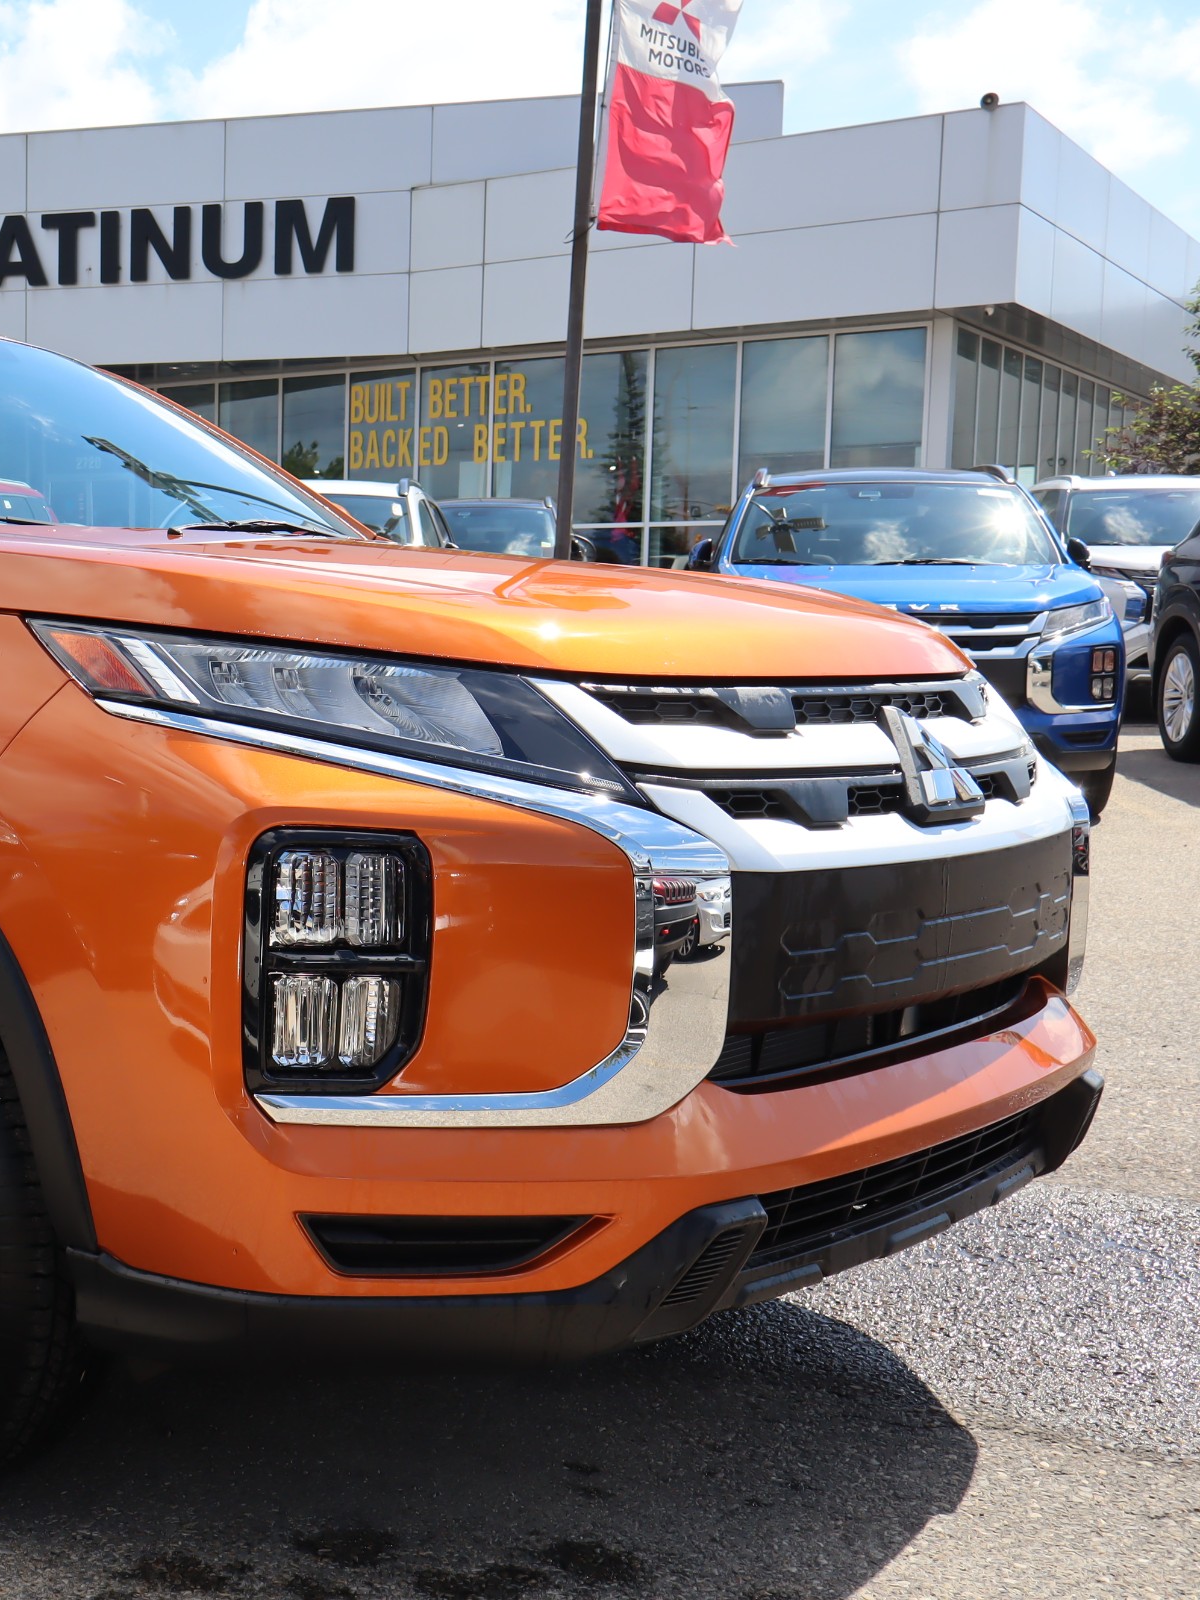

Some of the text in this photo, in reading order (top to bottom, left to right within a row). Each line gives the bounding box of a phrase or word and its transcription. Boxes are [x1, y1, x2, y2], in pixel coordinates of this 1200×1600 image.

[640, 23, 705, 63] MITSUBI
[648, 48, 712, 78] MOTORS
[350, 373, 533, 424] BUILT BETTER.
[349, 417, 594, 470] BACKED BETTER.
